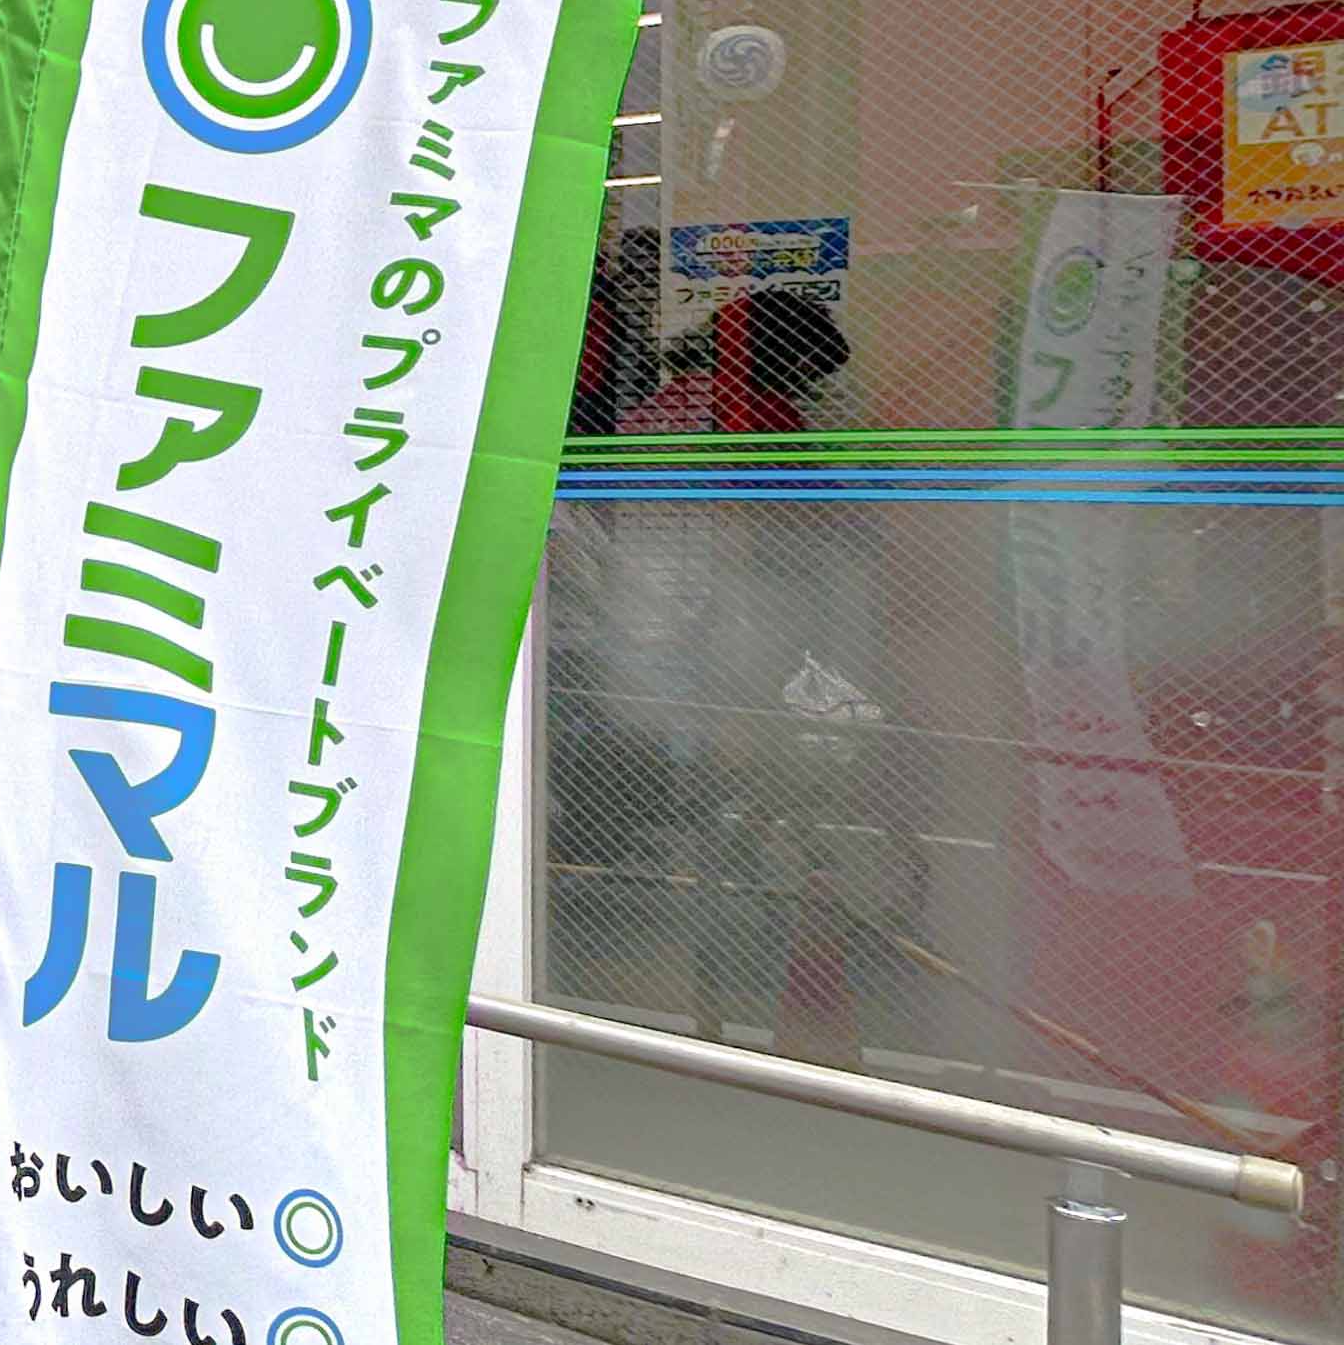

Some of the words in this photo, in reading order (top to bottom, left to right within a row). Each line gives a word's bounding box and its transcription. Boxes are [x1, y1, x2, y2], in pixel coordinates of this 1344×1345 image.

[23, 182, 297, 1043] ファミマル
[11, 1141, 254, 1240] おいしい
[23, 1253, 248, 1345] うれしい
